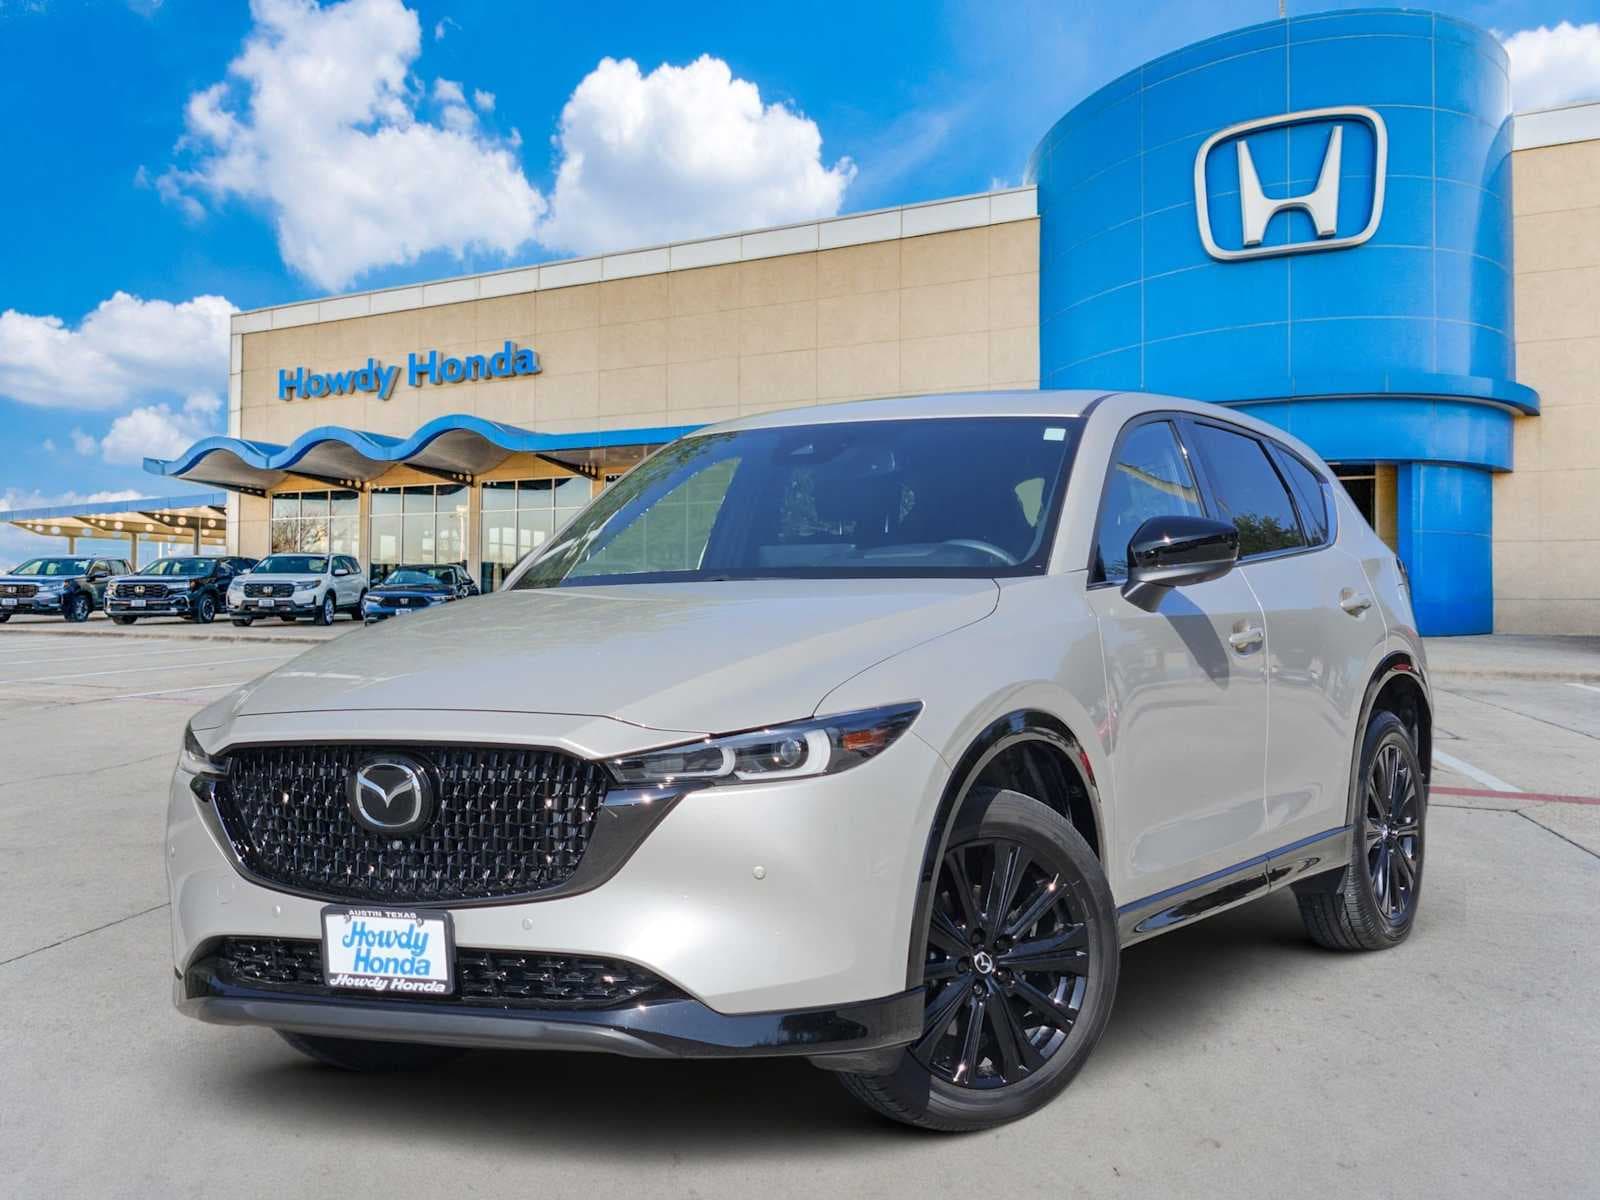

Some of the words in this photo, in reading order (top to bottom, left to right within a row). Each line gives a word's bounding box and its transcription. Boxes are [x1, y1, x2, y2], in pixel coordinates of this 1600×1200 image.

[279, 358, 401, 401] Howdy
[408, 341, 541, 387] Honda
[348, 909, 382, 918] AUSTIN
[385, 911, 417, 920] TEXAS
[342, 921, 429, 957] Howdy
[353, 947, 431, 976] Honda
[329, 974, 387, 991] Howdy
[390, 978, 446, 993] Honda
